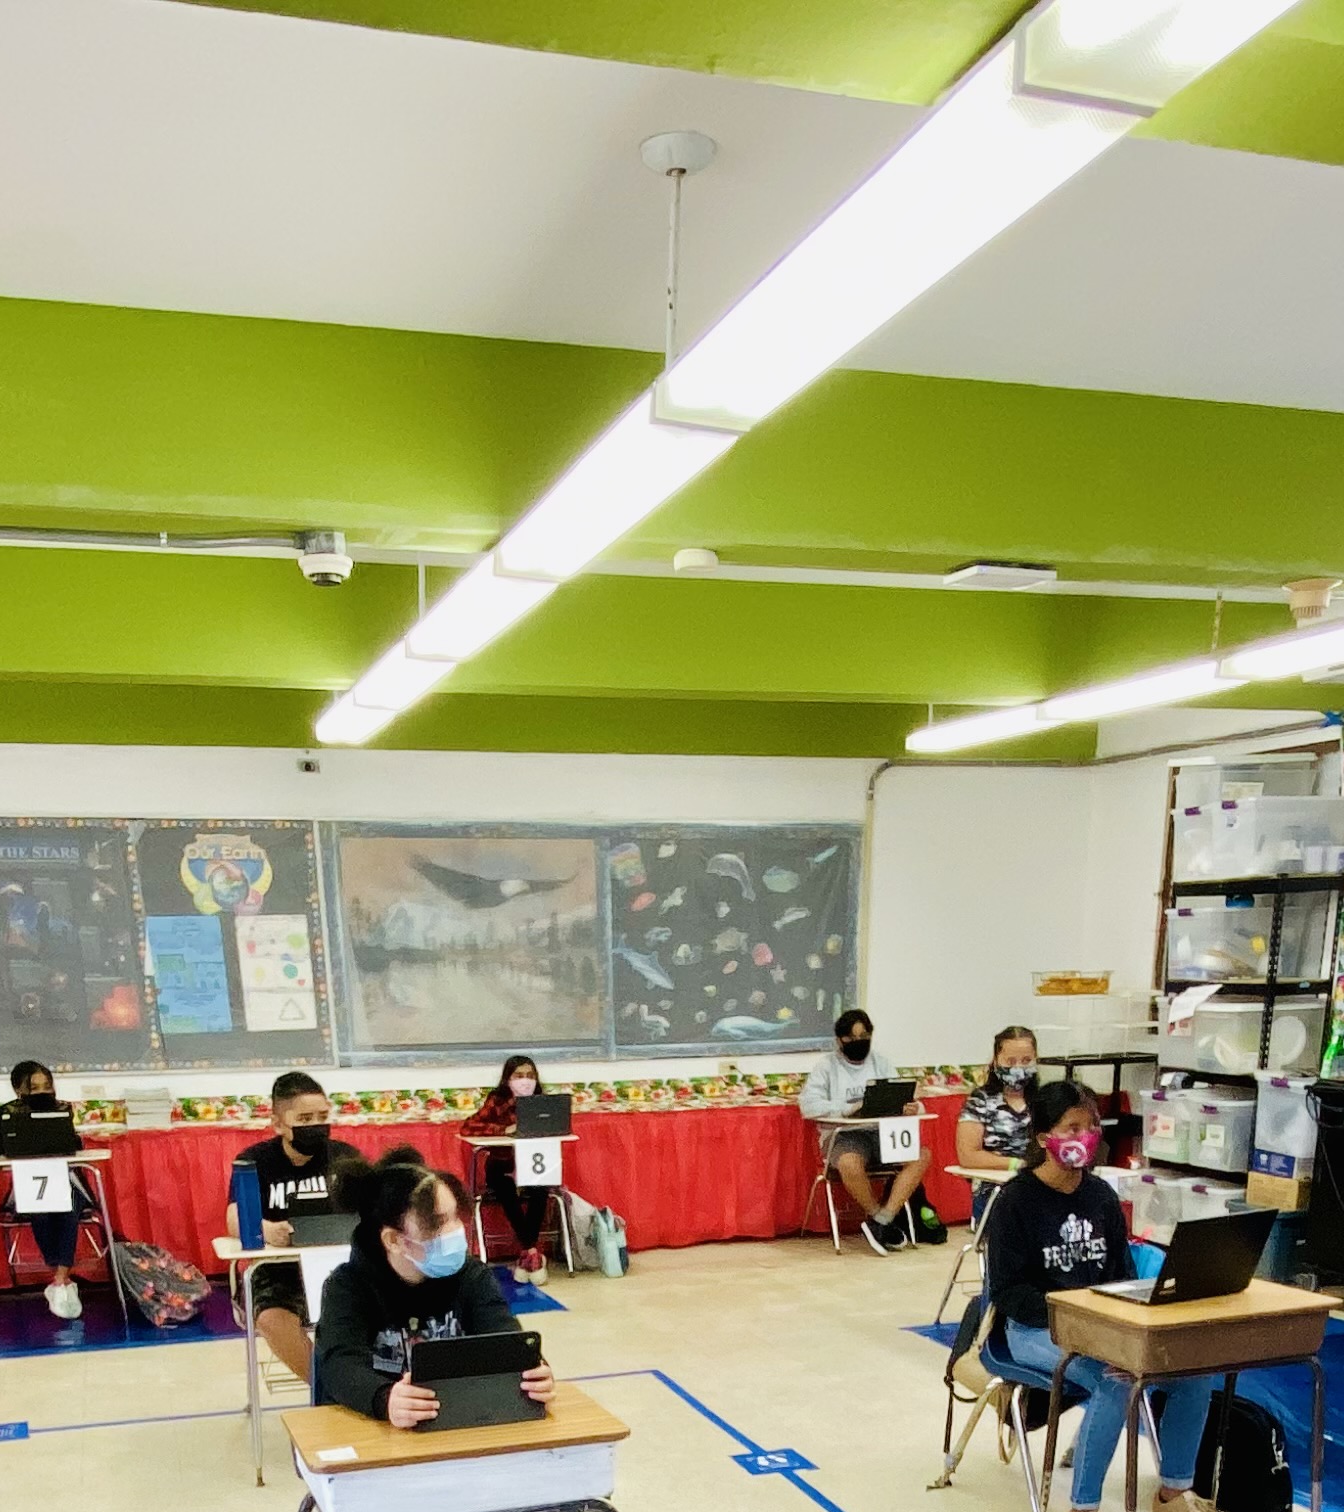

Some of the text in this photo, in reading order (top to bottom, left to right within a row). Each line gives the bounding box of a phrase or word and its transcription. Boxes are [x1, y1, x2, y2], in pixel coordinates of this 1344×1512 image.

[32, 846, 80, 859] STARS
[188, 846, 216, 860] Our
[890, 1130, 911, 1149] 10
[532, 1152, 546, 1175] 8
[32, 1176, 48, 1201] 7
